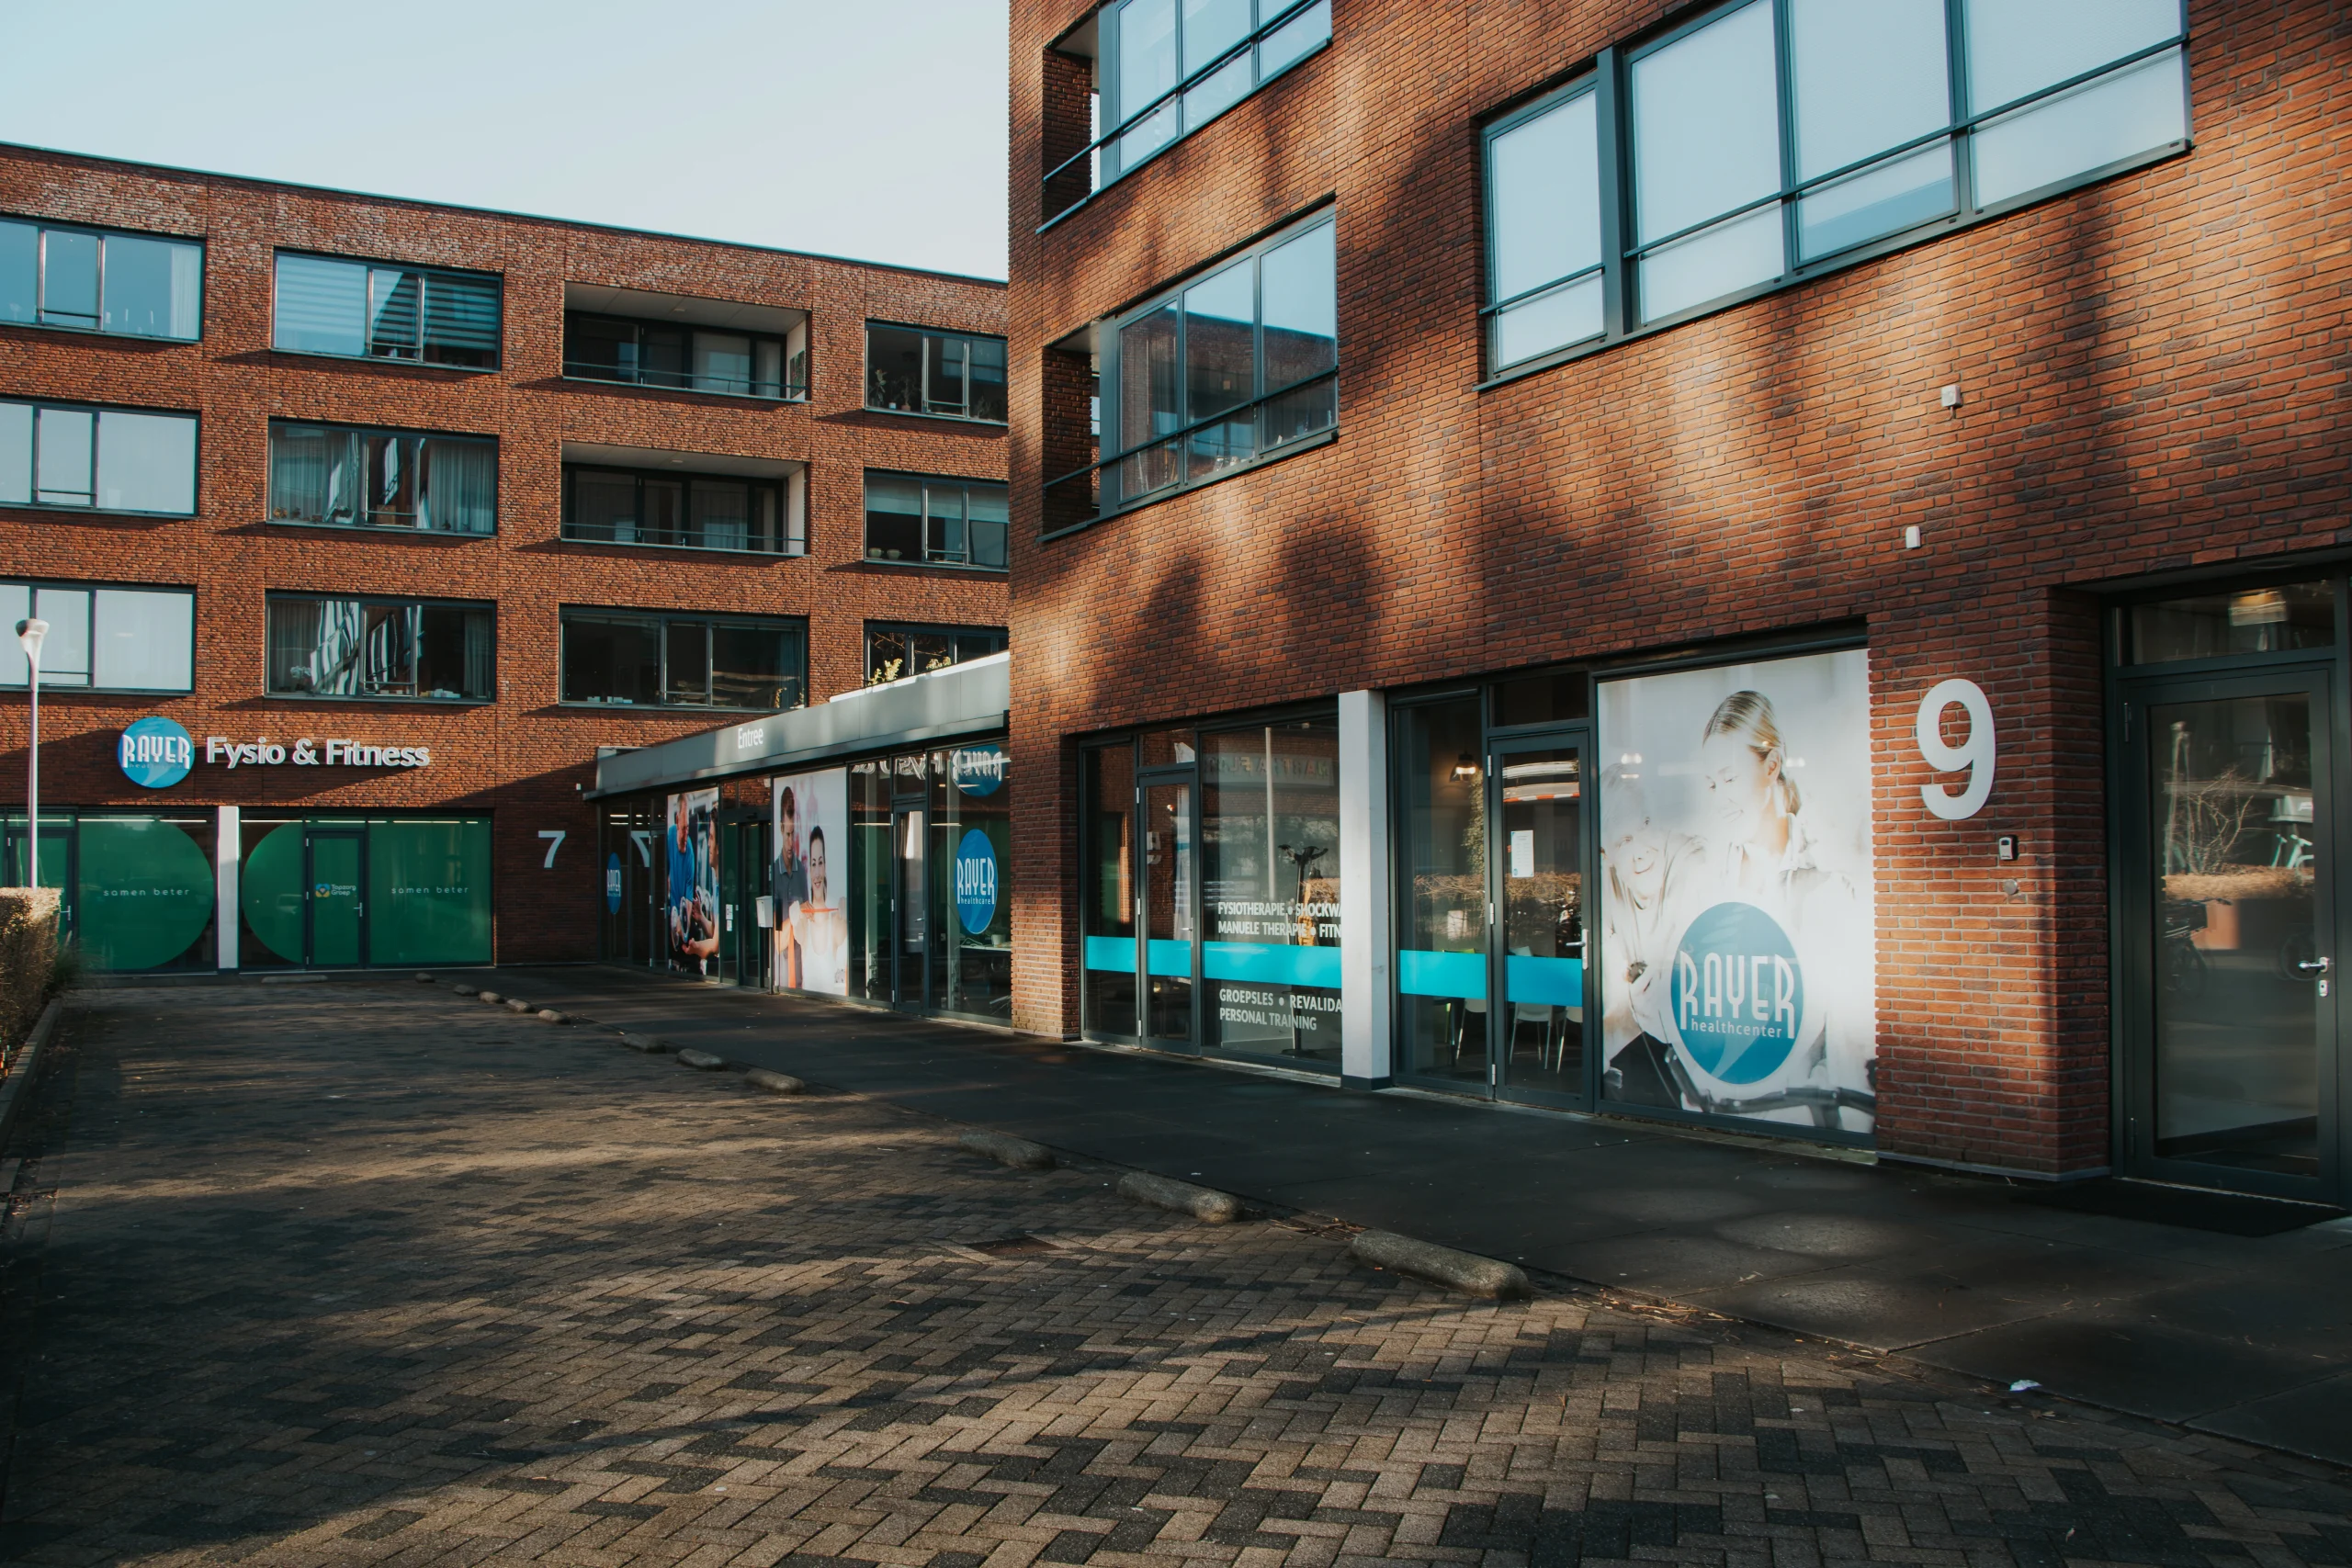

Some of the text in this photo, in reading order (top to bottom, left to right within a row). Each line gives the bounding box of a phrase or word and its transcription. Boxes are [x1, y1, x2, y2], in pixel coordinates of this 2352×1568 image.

[738, 728, 763, 749] Entree
[1917, 678, 1996, 820] 9
[122, 734, 189, 769] RAYER
[207, 736, 430, 769] Fysio & Fitness
[537, 830, 566, 868] 7
[153, 887, 190, 896] beter
[436, 886, 469, 894] beter
[956, 856, 995, 905] RAYER
[961, 897, 991, 905] healthcare
[1217, 901, 1285, 916] FYSIOTHERAPIE
[1217, 920, 1341, 938] MANUELE THERAPIE FITN
[1219, 988, 1342, 1012] GROEPSLES REVALIDA
[1679, 950, 1795, 1039] RAYER
[1219, 1008, 1317, 1031] PERSONAL TRAINING
[1690, 1018, 1782, 1038] healthcenter
